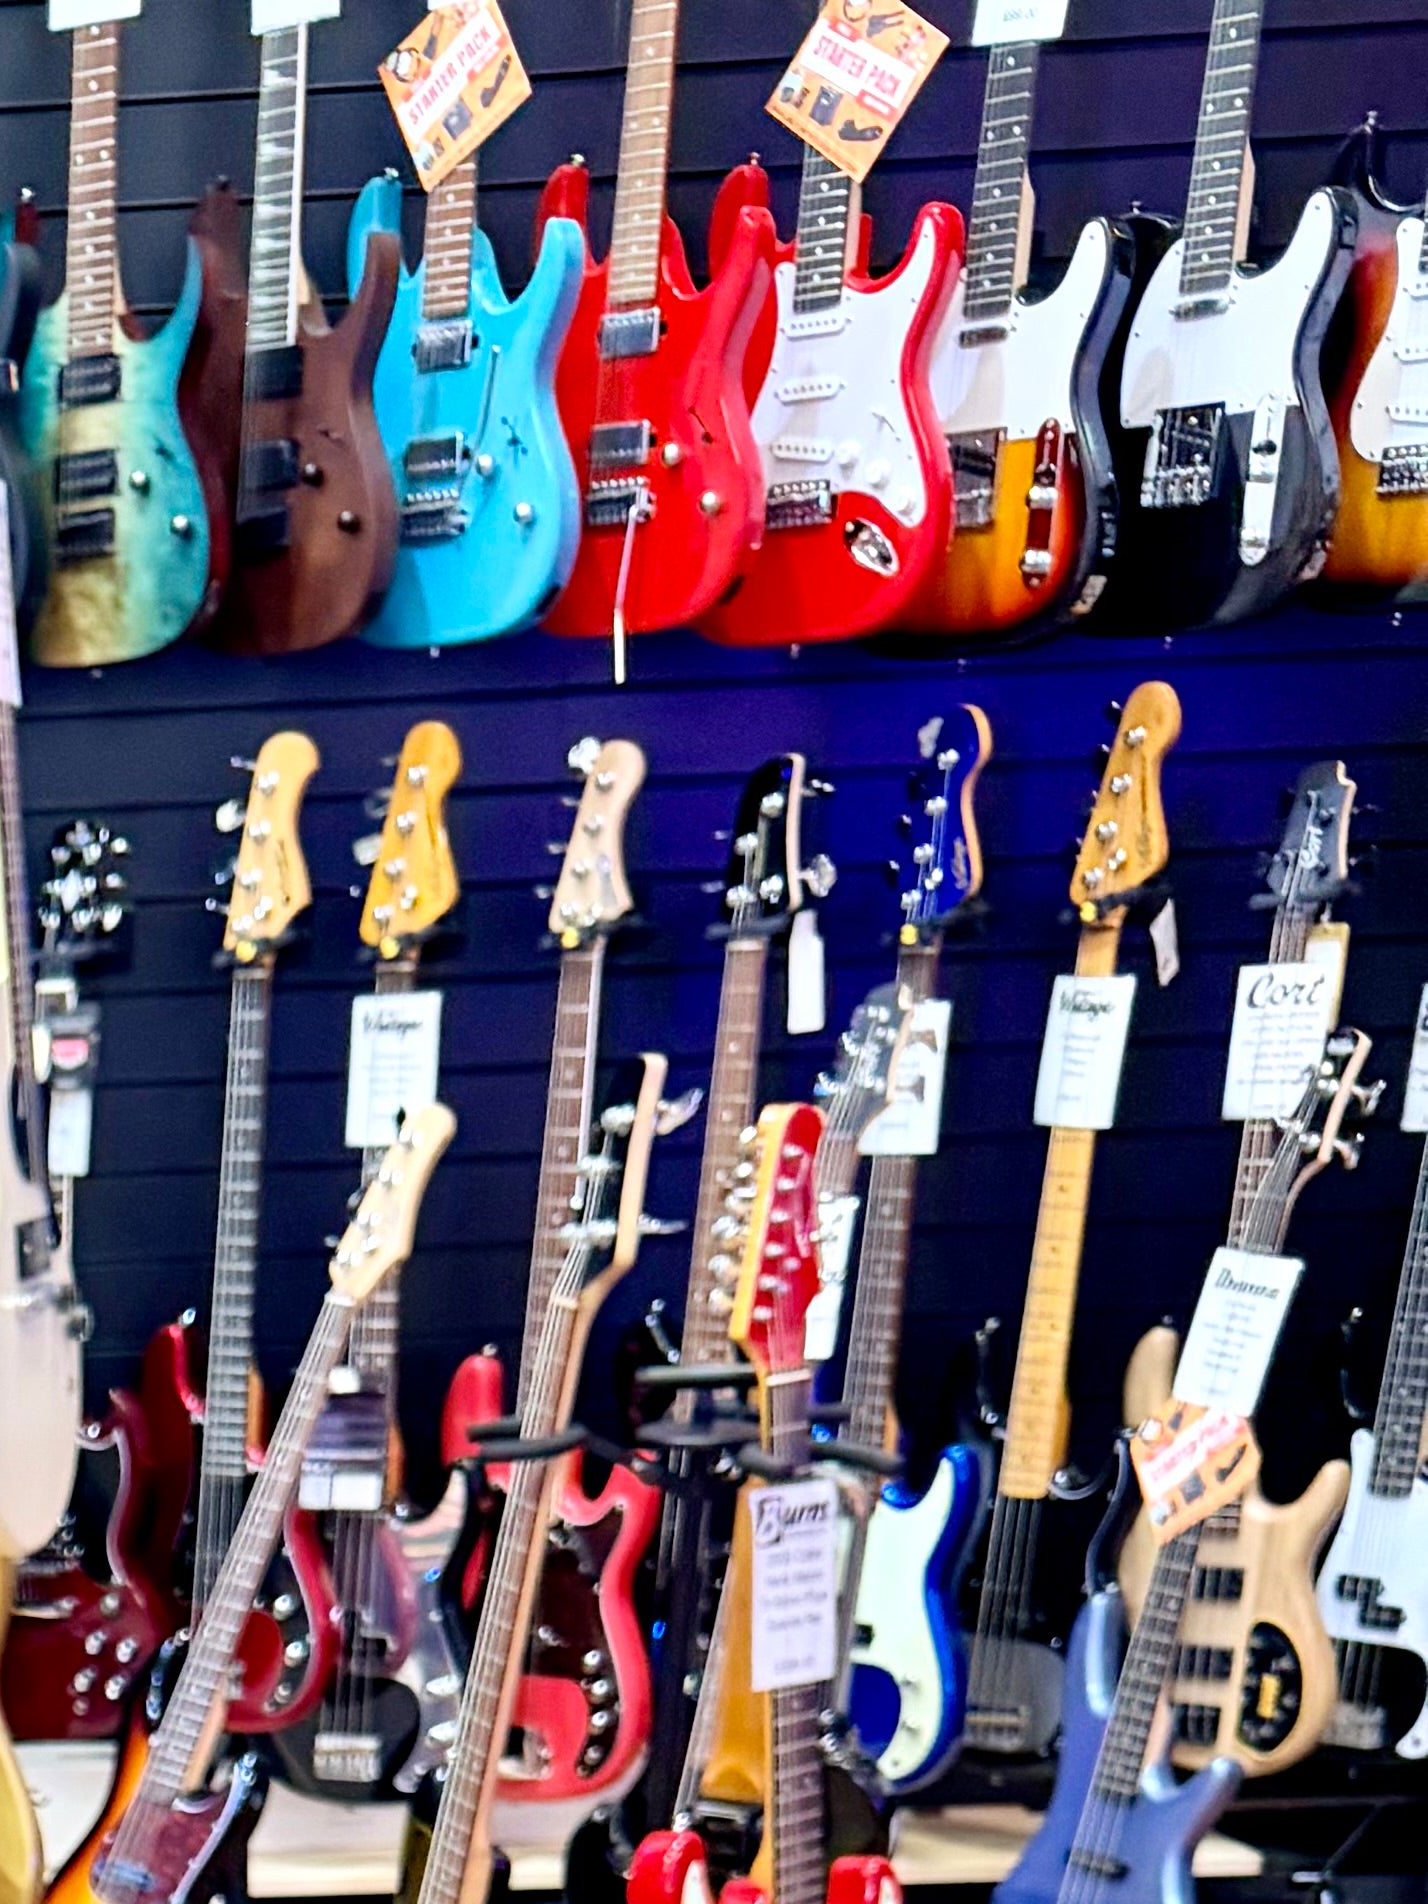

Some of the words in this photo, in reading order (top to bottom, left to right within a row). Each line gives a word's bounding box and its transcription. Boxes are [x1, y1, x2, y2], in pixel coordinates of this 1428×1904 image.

[408, 61, 458, 125] STARTER
[456, 26, 491, 67] PACK
[813, 35, 868, 79] STARTER
[867, 65, 901, 97] PACK
[1246, 971, 1325, 1010] Cort
[755, 1494, 829, 1549] Burns
